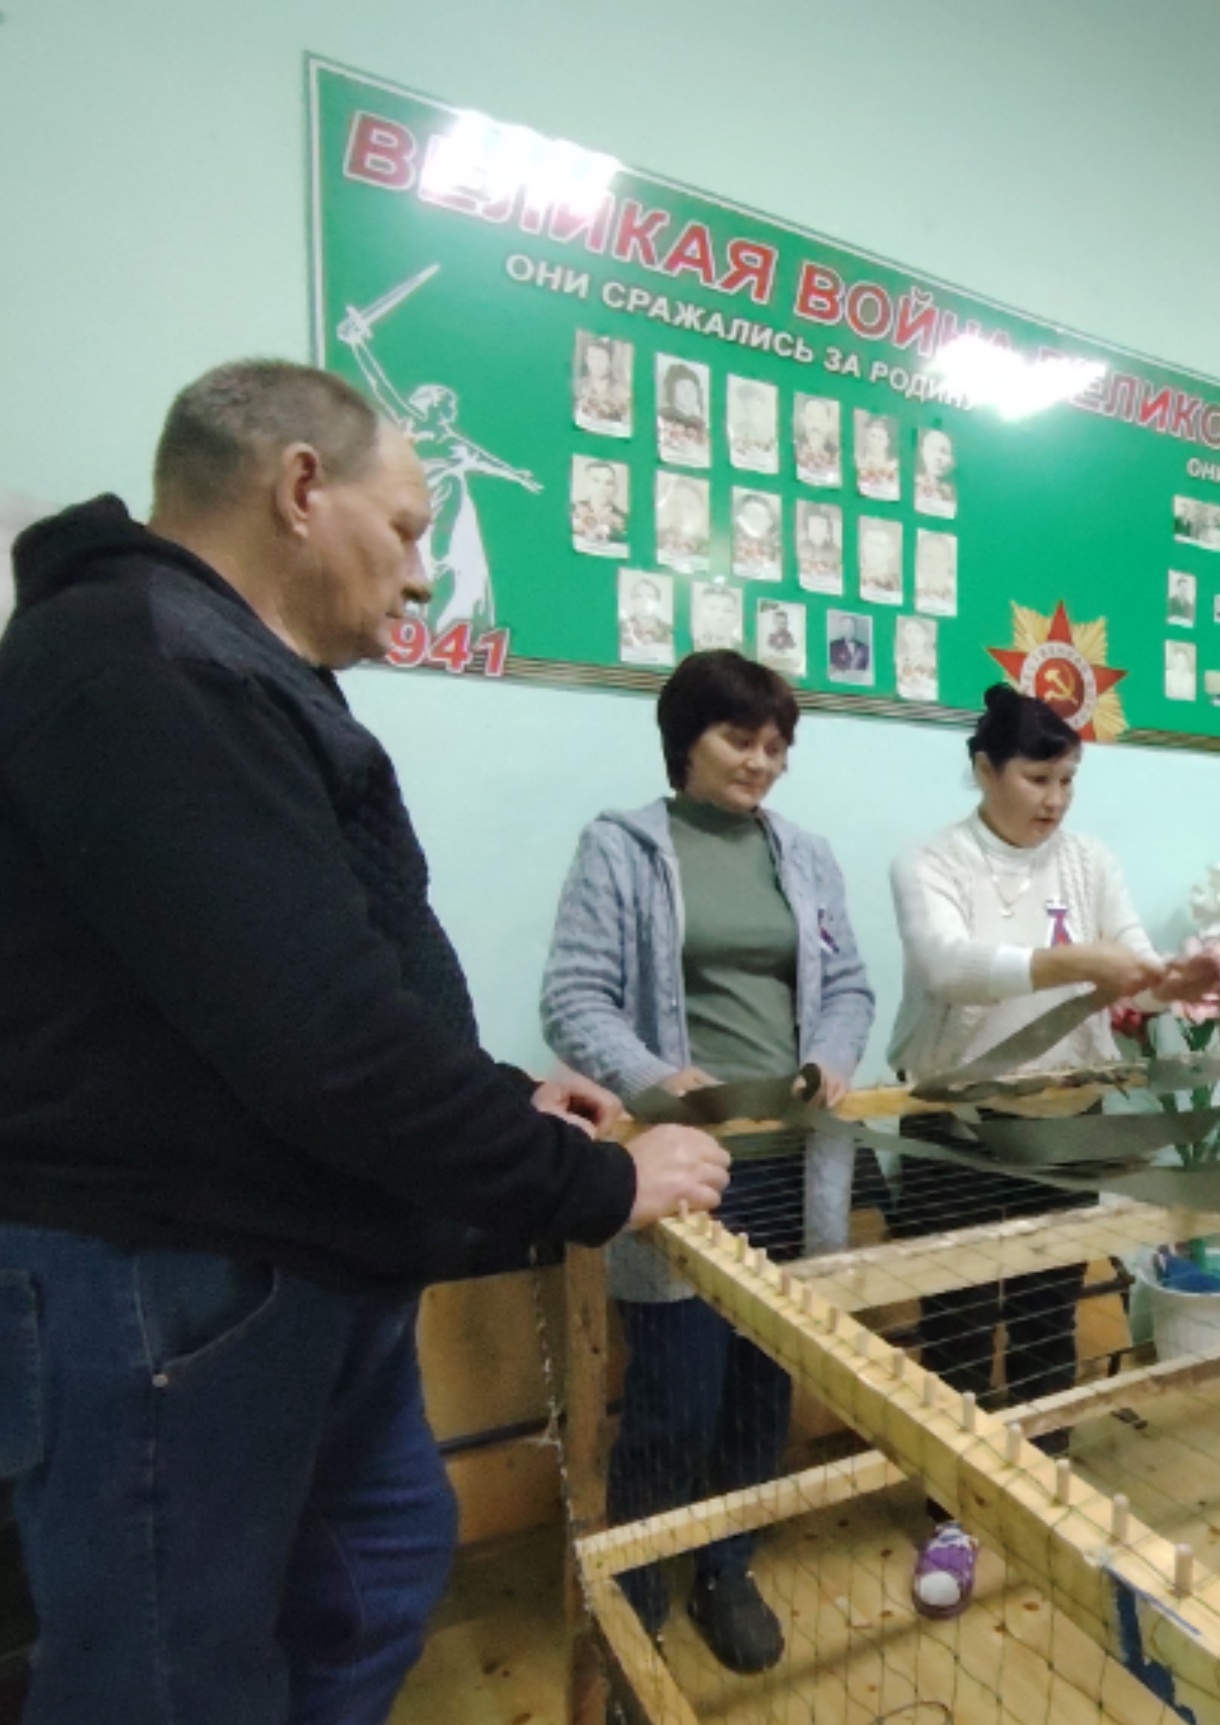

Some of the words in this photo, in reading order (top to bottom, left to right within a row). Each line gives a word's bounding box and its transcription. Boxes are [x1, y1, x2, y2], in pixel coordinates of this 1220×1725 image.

[343, 110, 777, 305] ВИКАЯ
[794, 261, 1022, 374] ВОЙ
[506, 252, 591, 299] ОНИ
[602, 280, 815, 364] СРАЖАЛИСЬ
[822, 346, 861, 378] ЗА
[869, 361, 975, 411] РОДИ
[386, 617, 511, 677] 941
